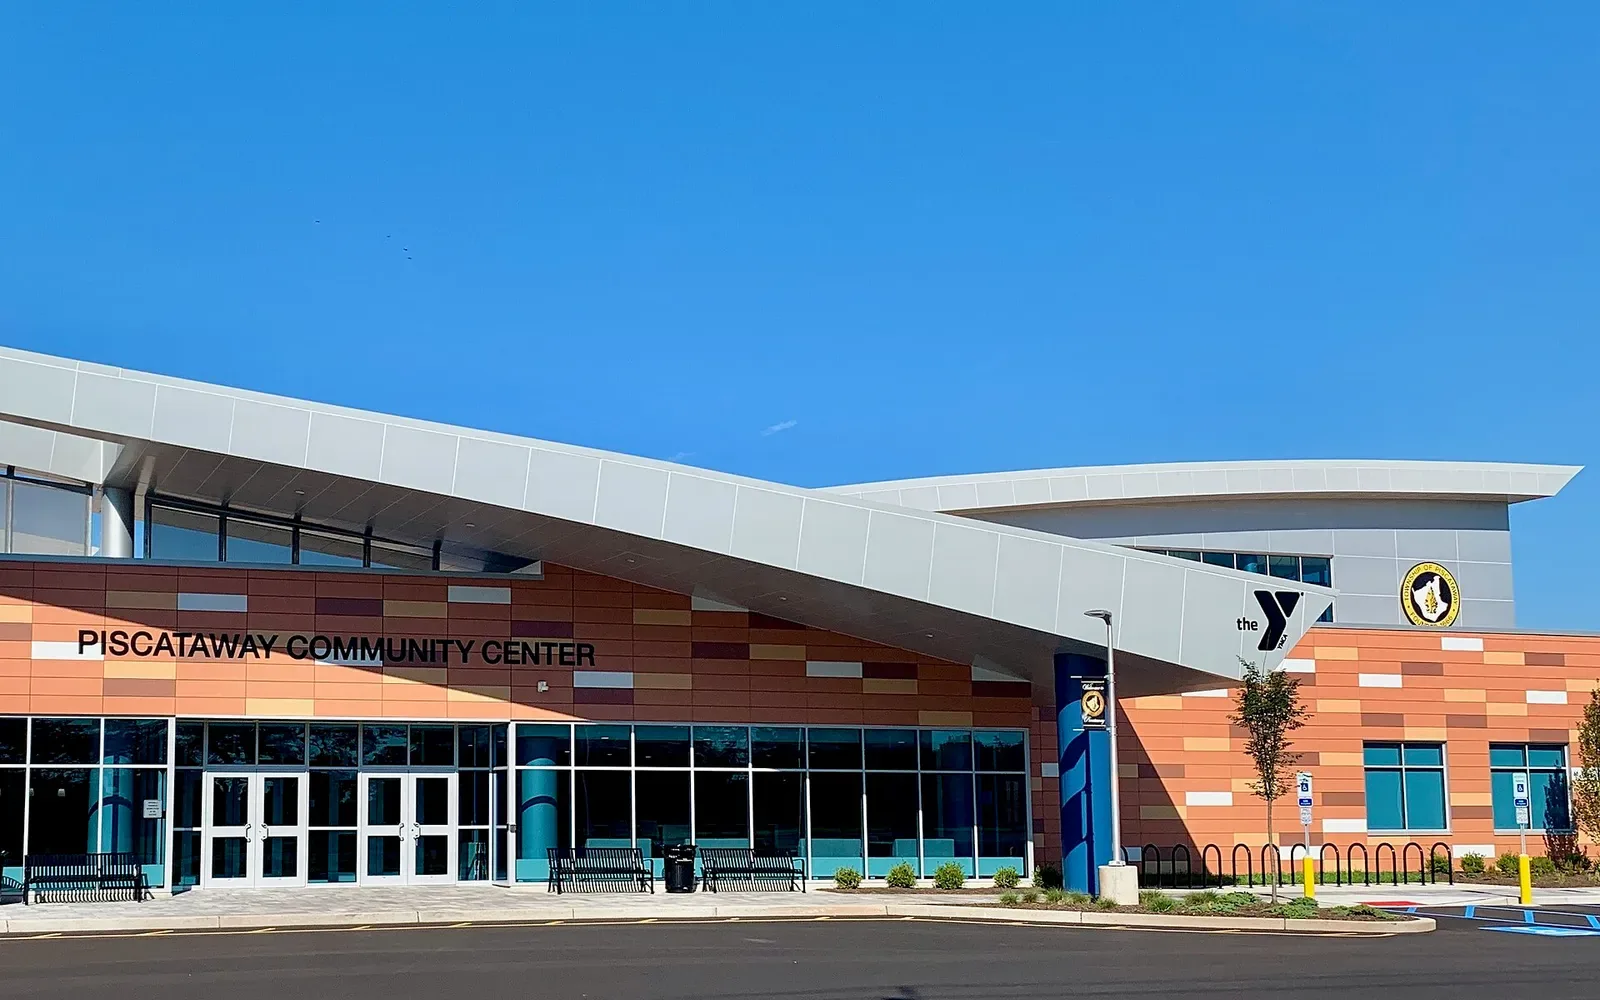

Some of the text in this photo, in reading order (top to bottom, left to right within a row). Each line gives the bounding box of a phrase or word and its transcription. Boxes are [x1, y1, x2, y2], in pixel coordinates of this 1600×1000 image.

[1434, 566, 1458, 605] PISCATAWAY
[1236, 590, 1300, 651] the Y
[78, 630, 596, 667] PISCATAWAY COMMUNITY CENTER
